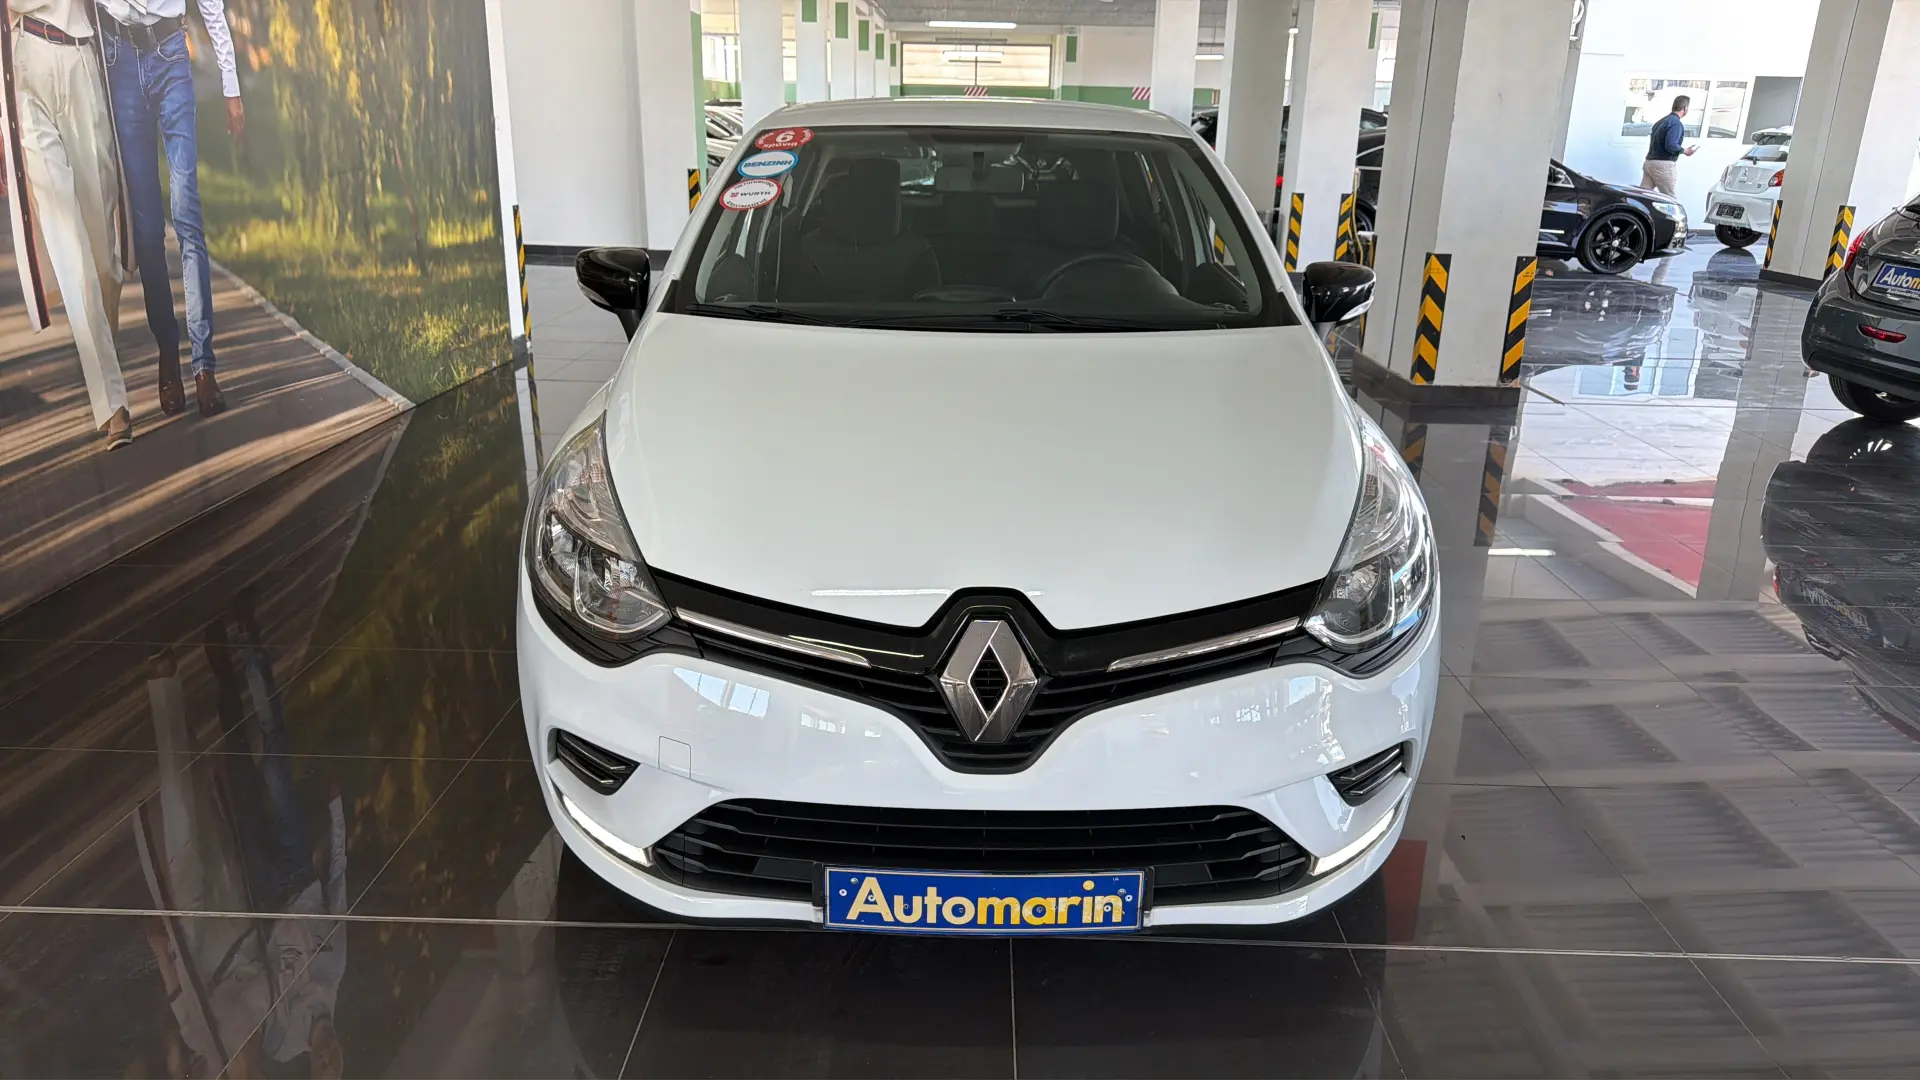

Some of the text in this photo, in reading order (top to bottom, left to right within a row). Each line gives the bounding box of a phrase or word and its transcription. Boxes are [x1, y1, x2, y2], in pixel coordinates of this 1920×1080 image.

[776, 131, 795, 143] 6
[743, 160, 792, 168] ΒΕΝΖΙΝΗ
[847, 876, 1123, 925] Automarin
